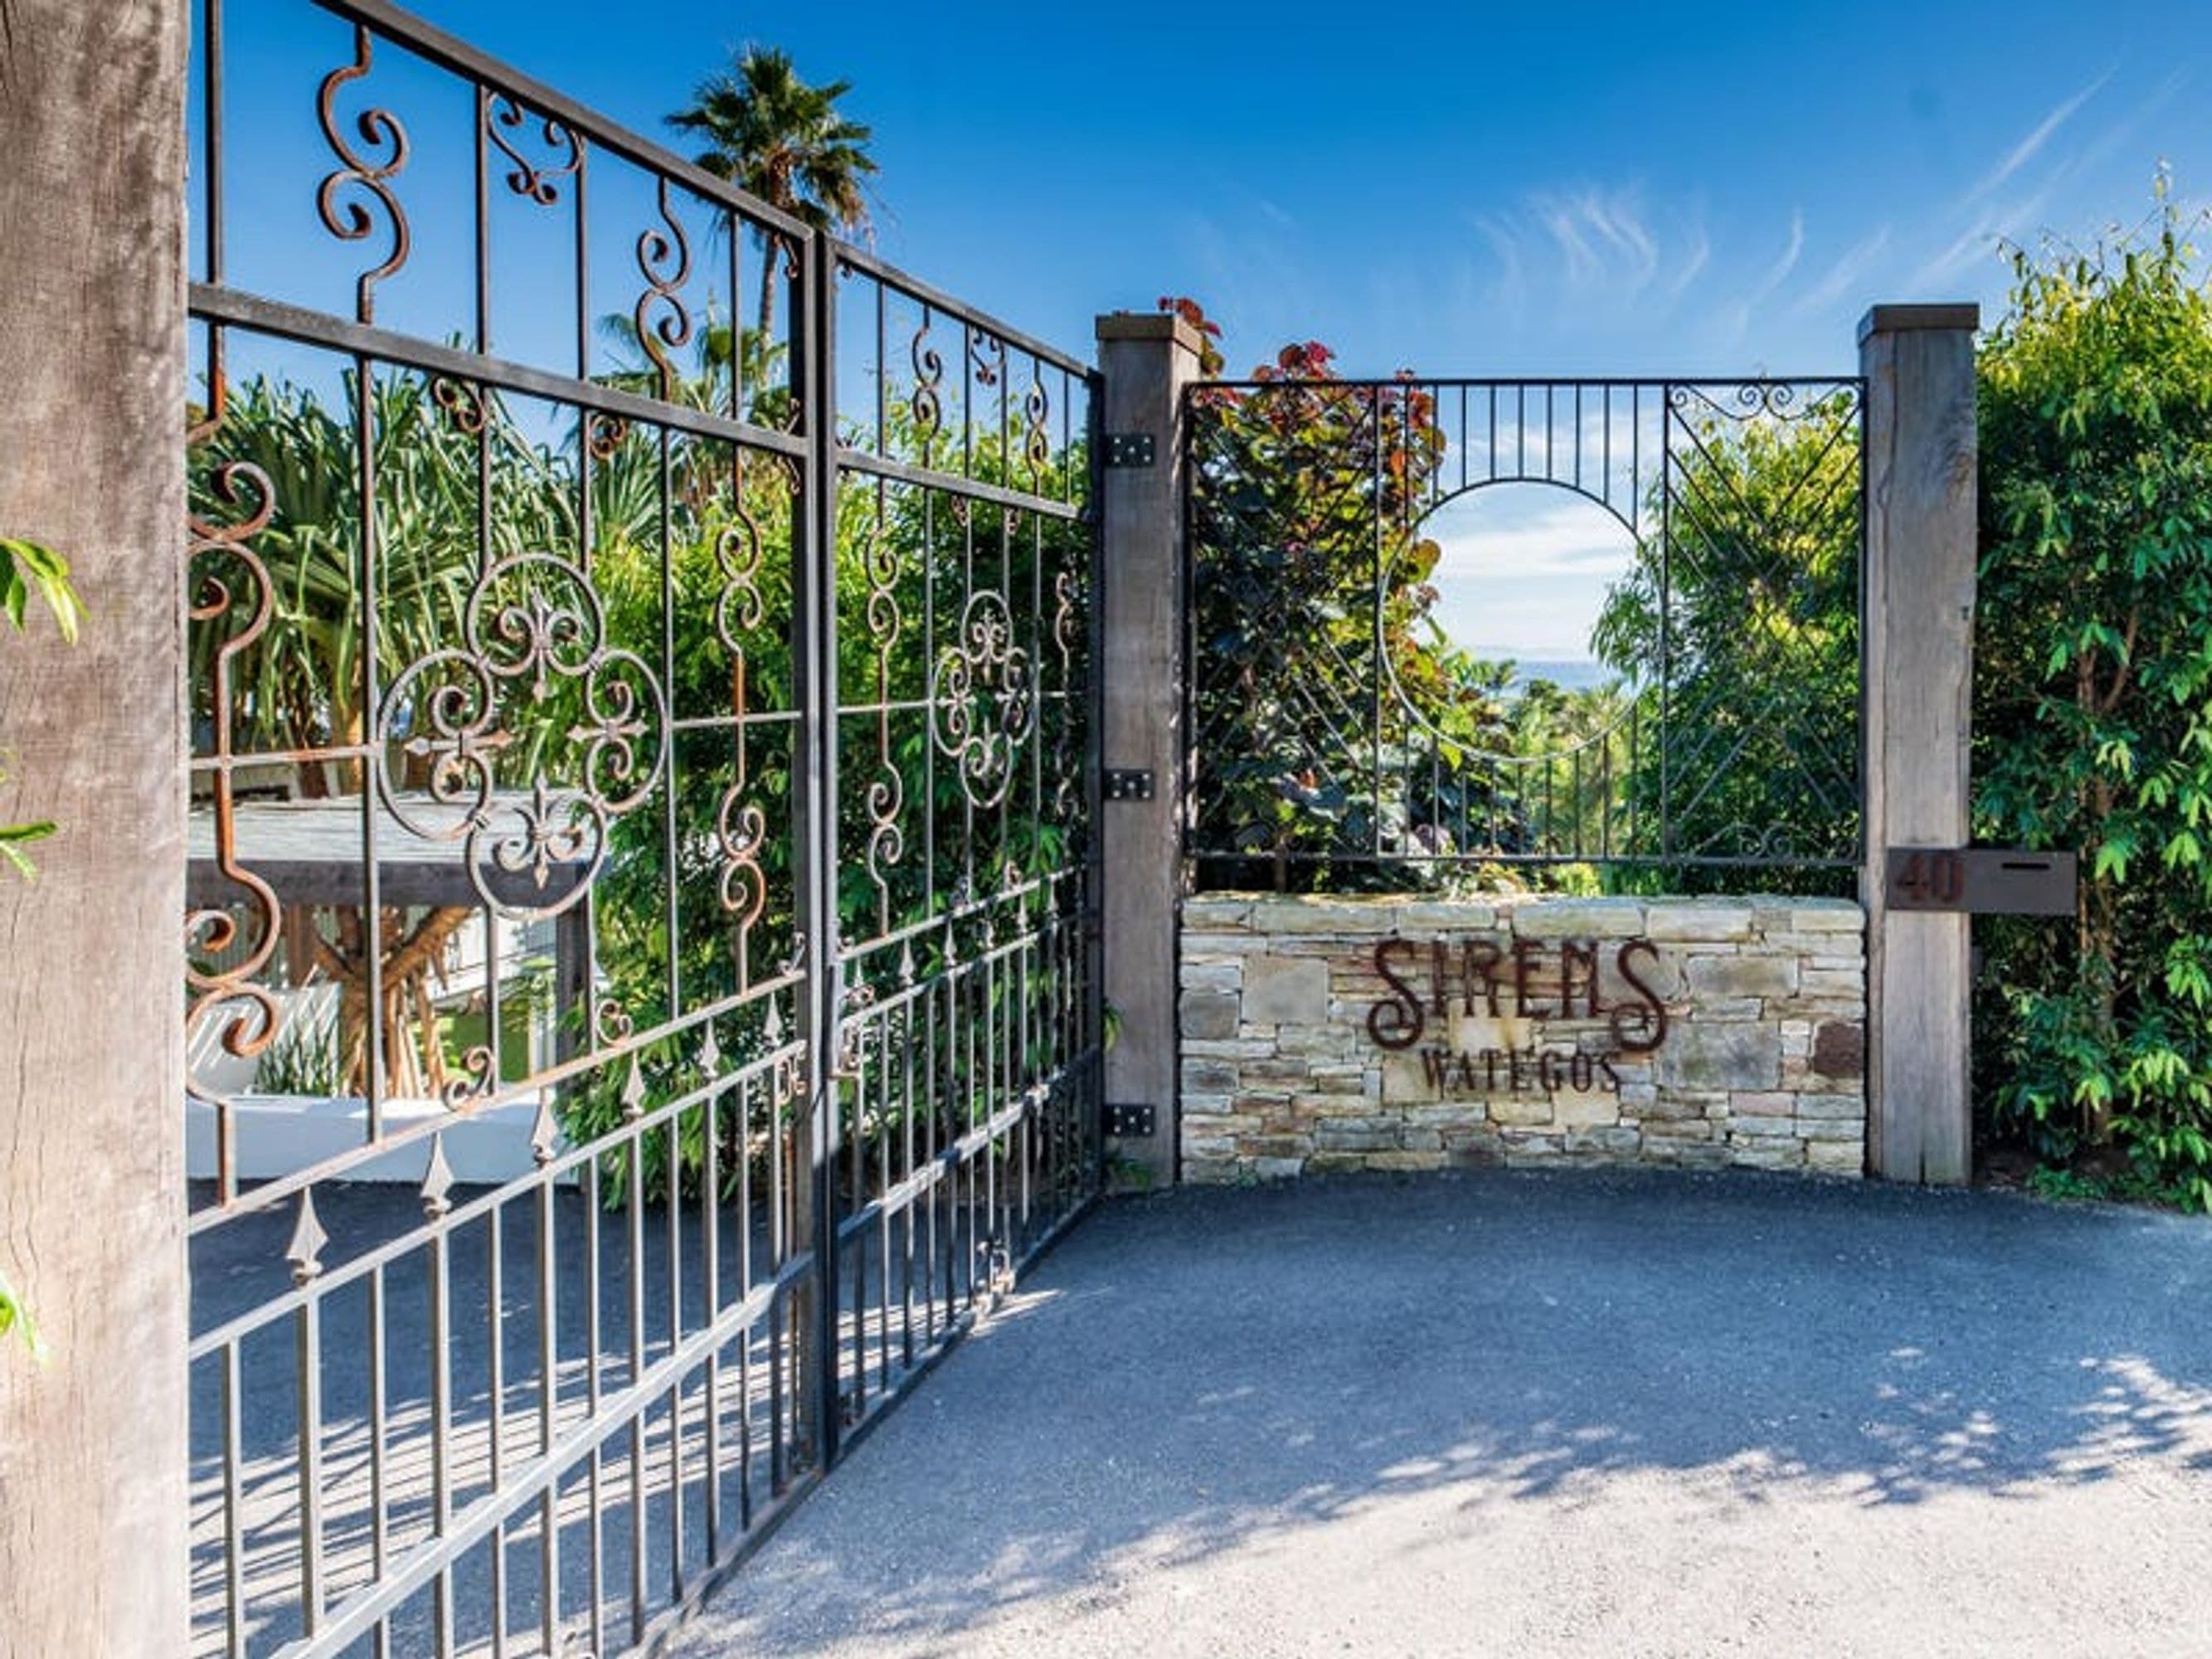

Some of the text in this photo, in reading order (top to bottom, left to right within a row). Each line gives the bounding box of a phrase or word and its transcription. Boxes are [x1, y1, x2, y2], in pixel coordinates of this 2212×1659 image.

[1897, 854, 1964, 902] 40
[1367, 937, 1667, 1052] SIRENS
[1421, 1048, 1621, 1092] WATEGOS
